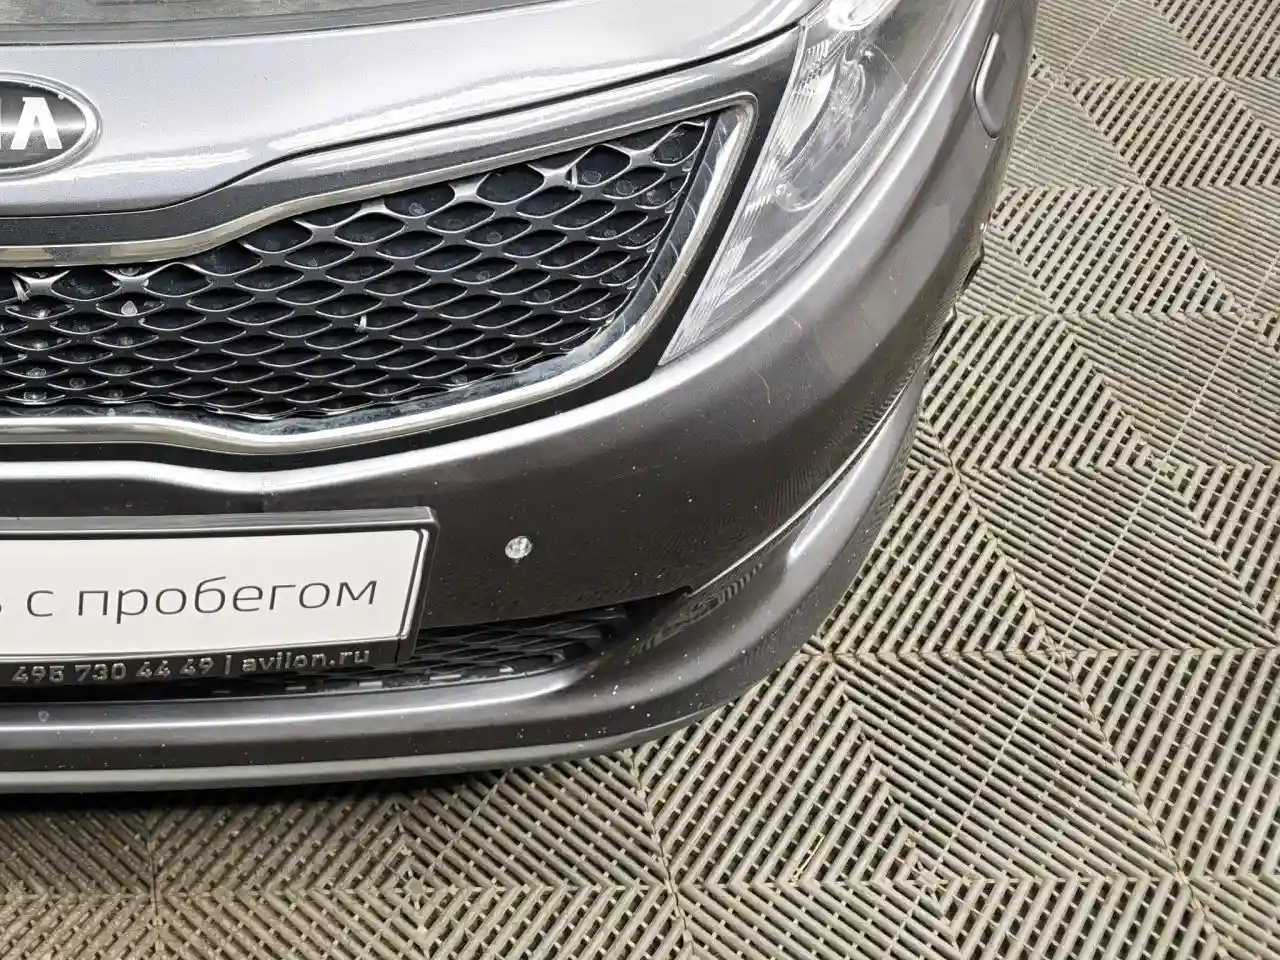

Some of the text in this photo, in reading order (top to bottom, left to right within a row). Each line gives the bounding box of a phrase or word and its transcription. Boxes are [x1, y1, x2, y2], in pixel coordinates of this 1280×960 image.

[25, 588, 55, 618] с
[77, 576, 378, 625] пробегом
[11, 664, 65, 686] 495
[74, 662, 127, 683] 730
[135, 659, 172, 680] 44
[179, 656, 216, 676] 49
[241, 648, 371, 674] avilon.ru
